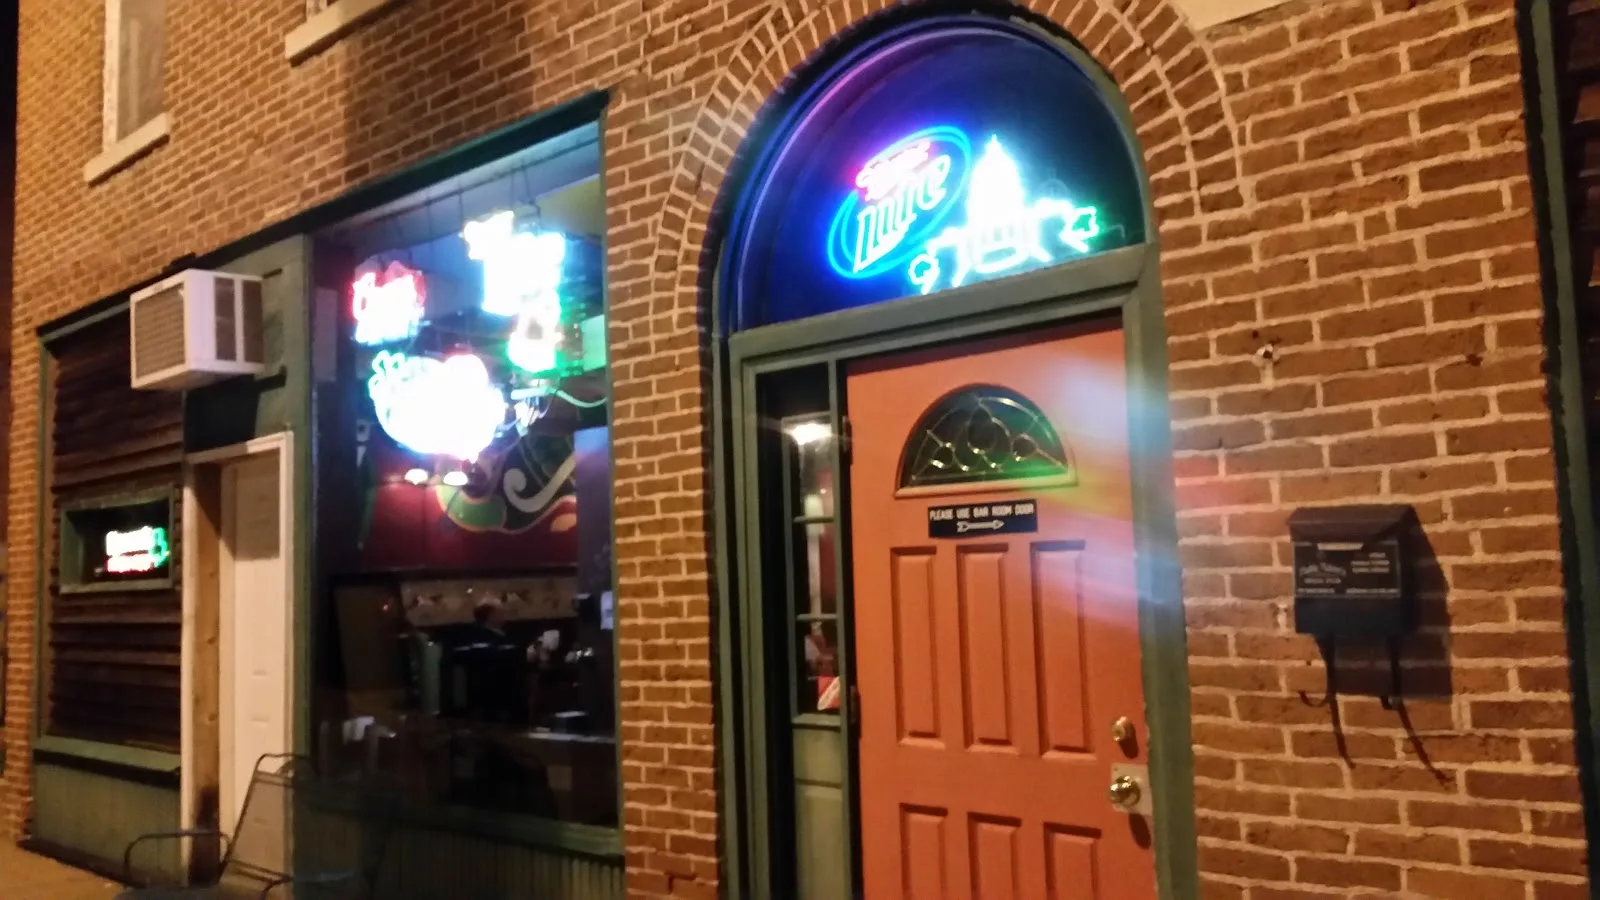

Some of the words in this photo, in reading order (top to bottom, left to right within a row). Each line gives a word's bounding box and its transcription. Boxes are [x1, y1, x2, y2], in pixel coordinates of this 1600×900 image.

[929, 509, 953, 520] PLEASE
[956, 508, 970, 519] USE
[973, 506, 989, 518] BAR
[991, 505, 1012, 516] ROOM
[1014, 503, 1034, 515] DOOR
